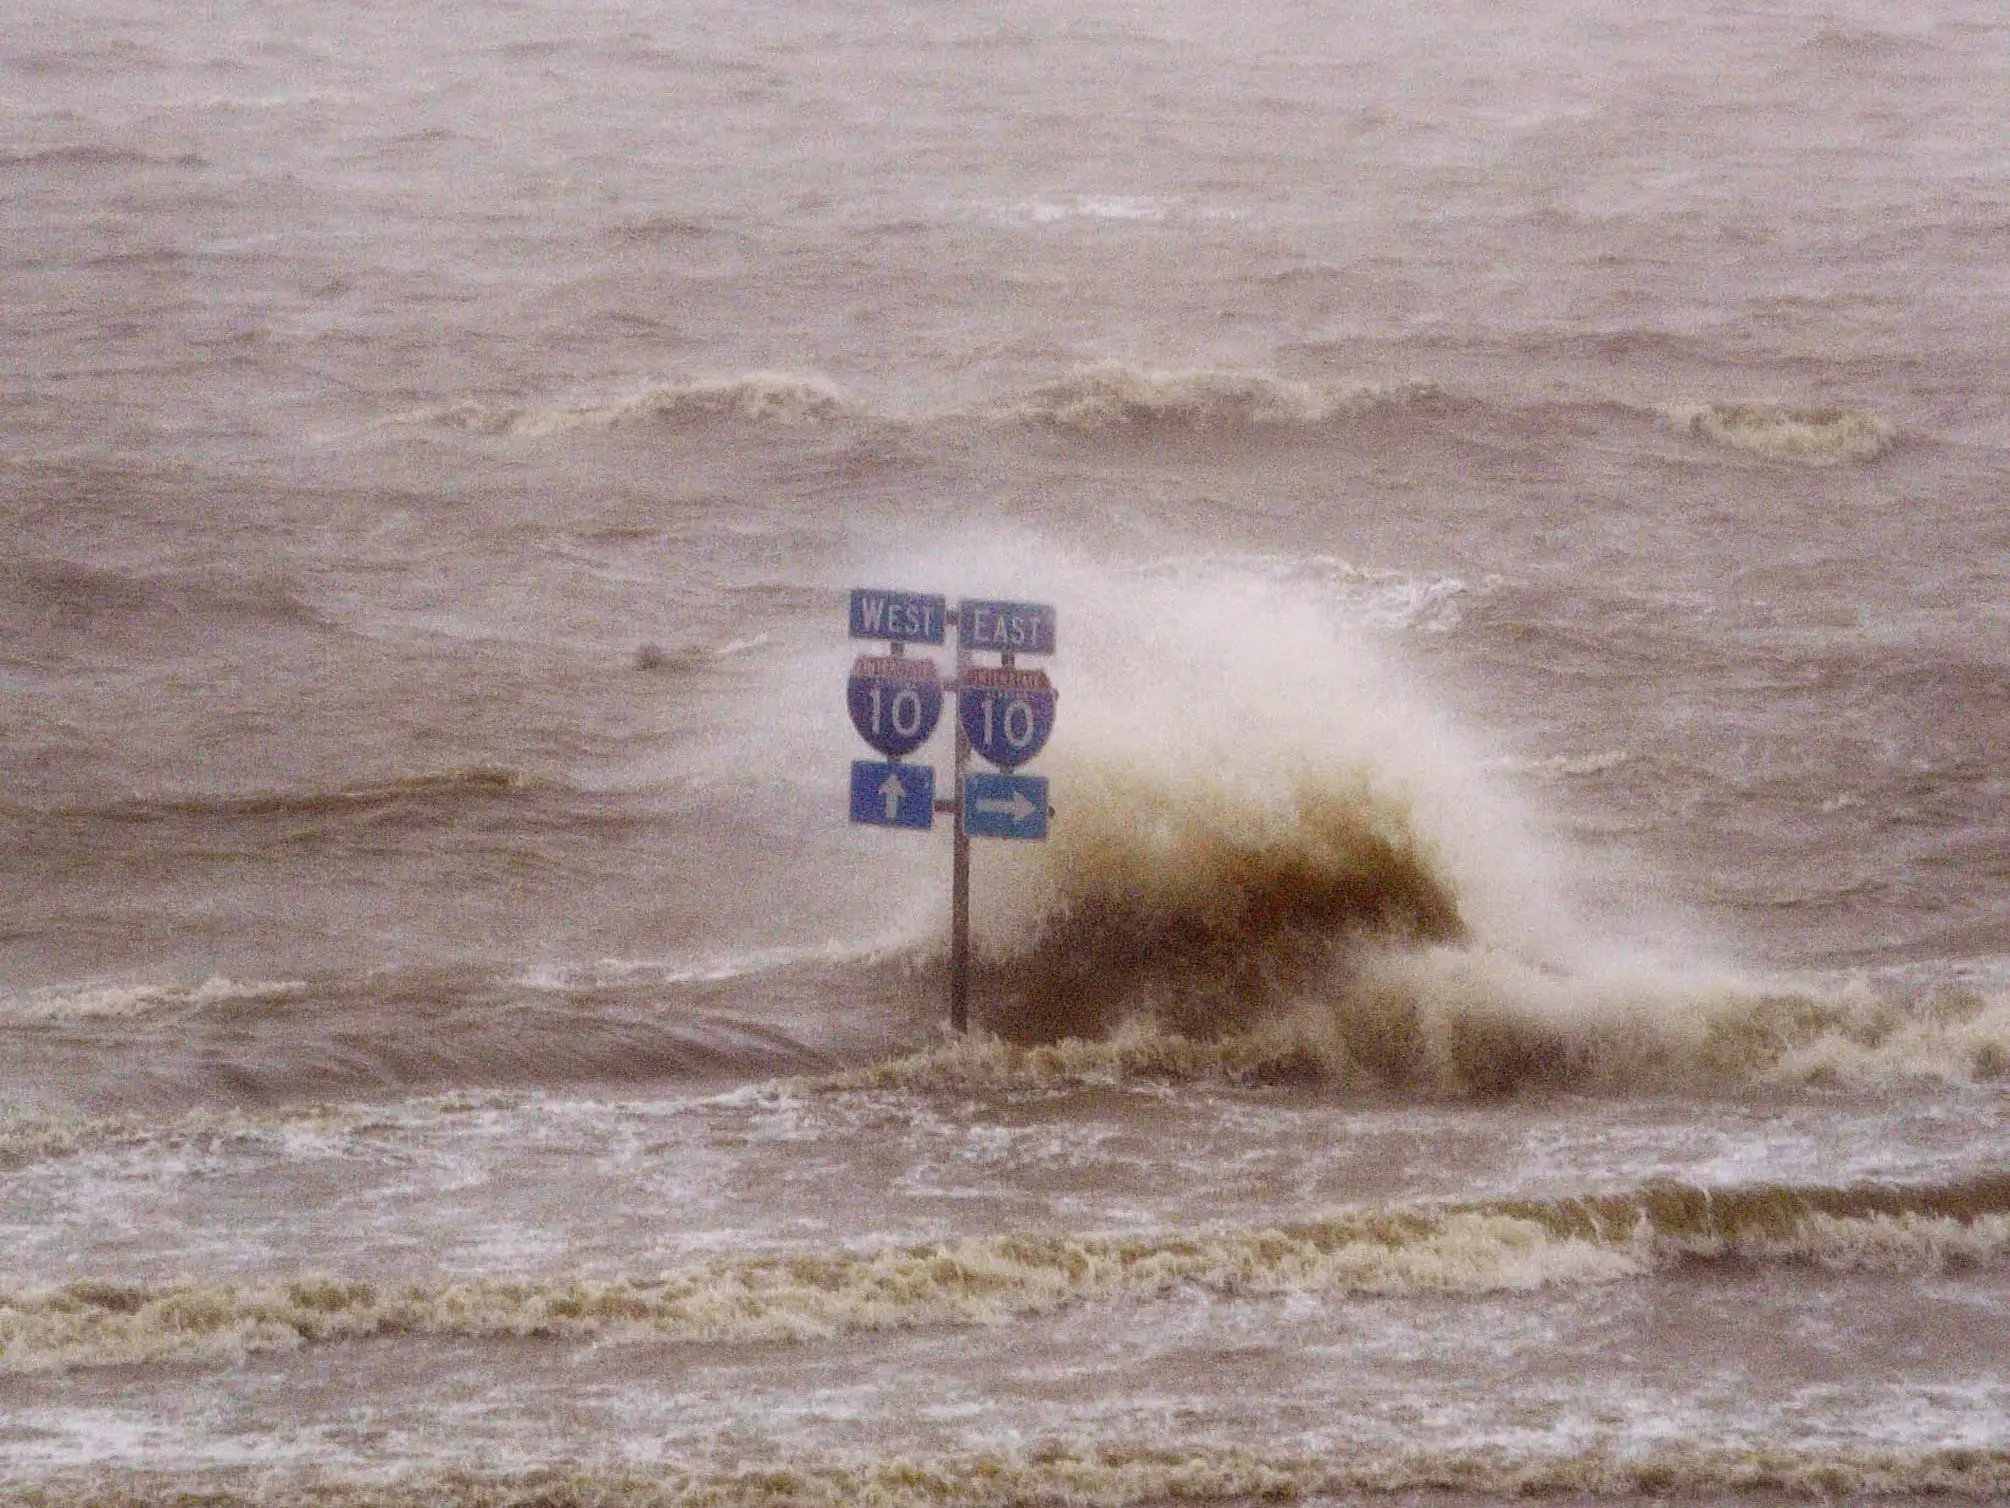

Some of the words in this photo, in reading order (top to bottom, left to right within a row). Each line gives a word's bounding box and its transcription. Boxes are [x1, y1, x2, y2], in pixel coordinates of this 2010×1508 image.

[862, 597, 936, 635] WEST
[973, 608, 1042, 646] EAST
[870, 688, 921, 736] 10
[981, 699, 1034, 748] 10
